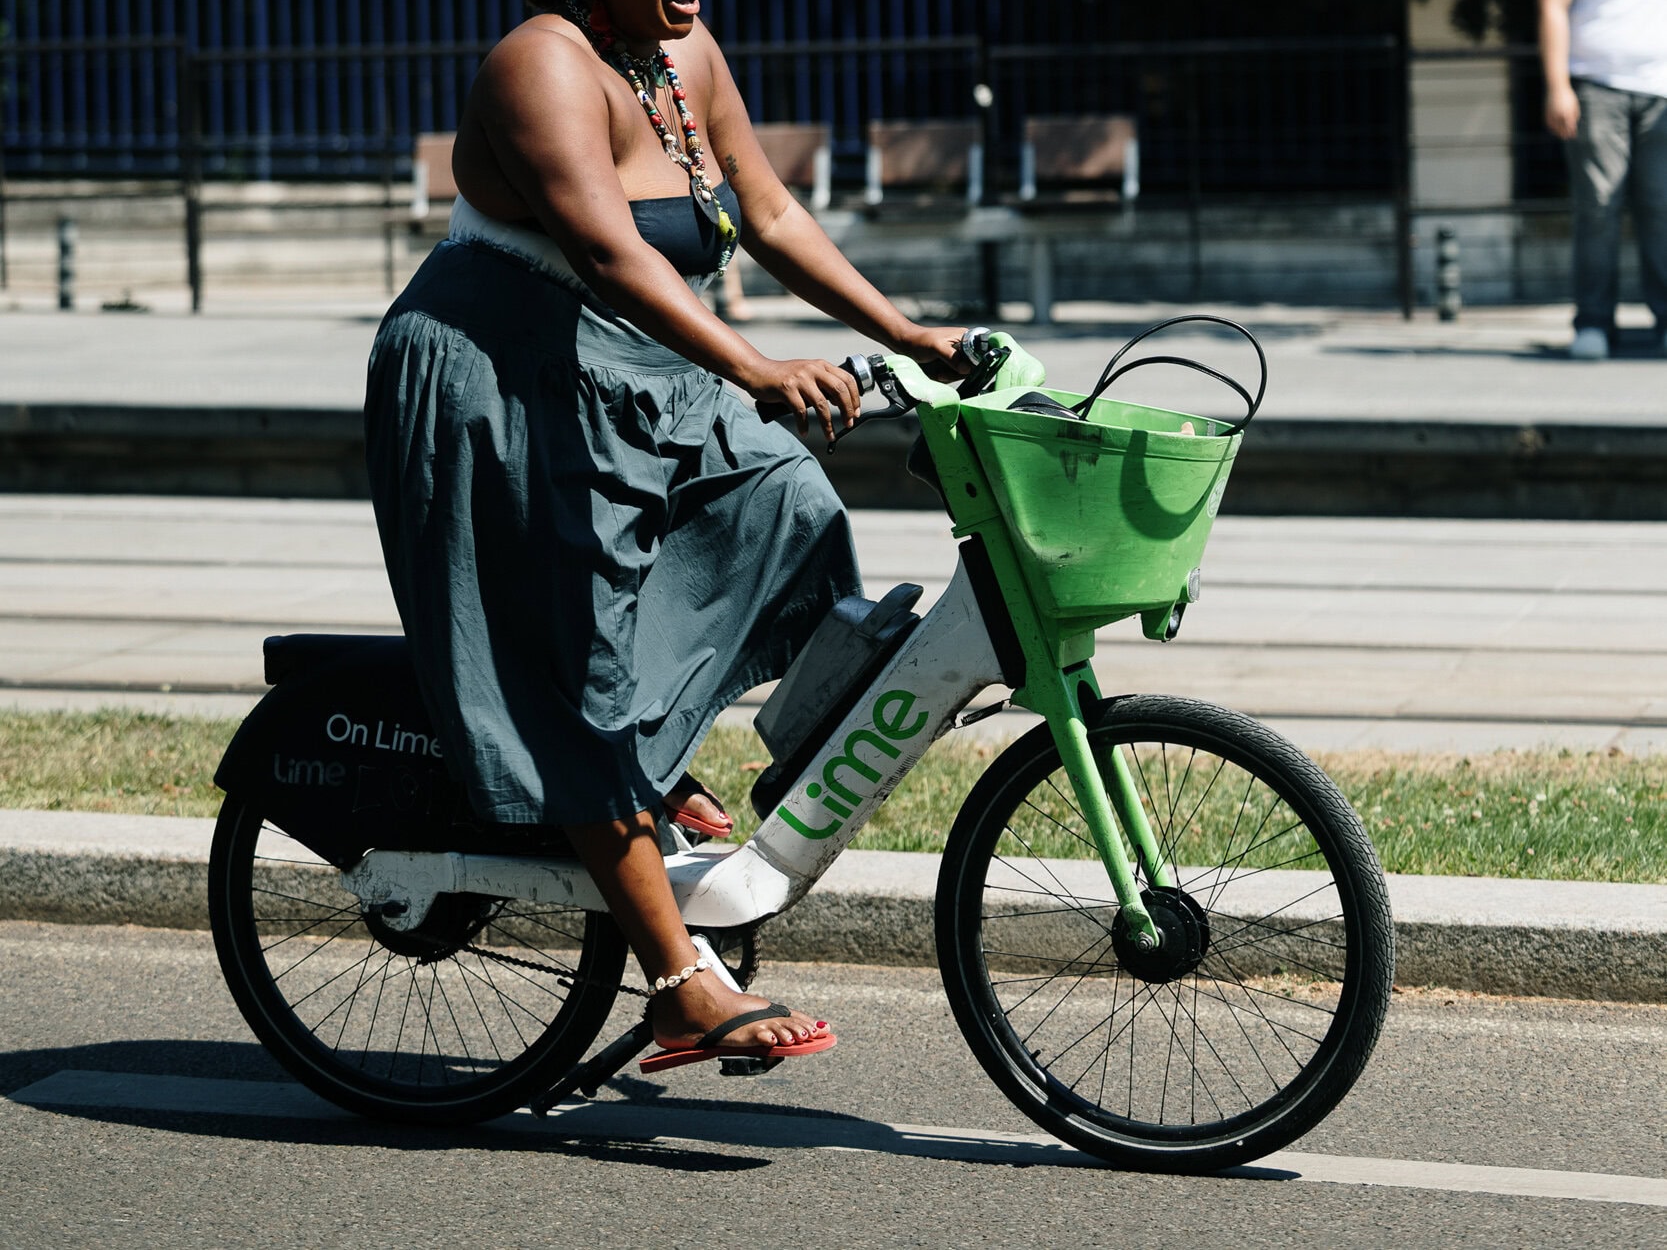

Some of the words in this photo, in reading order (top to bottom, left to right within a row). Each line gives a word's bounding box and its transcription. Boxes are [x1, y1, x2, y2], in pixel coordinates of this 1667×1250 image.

[326, 713, 369, 746] On
[272, 751, 347, 786] Lime
[777, 689, 929, 840] Lime
